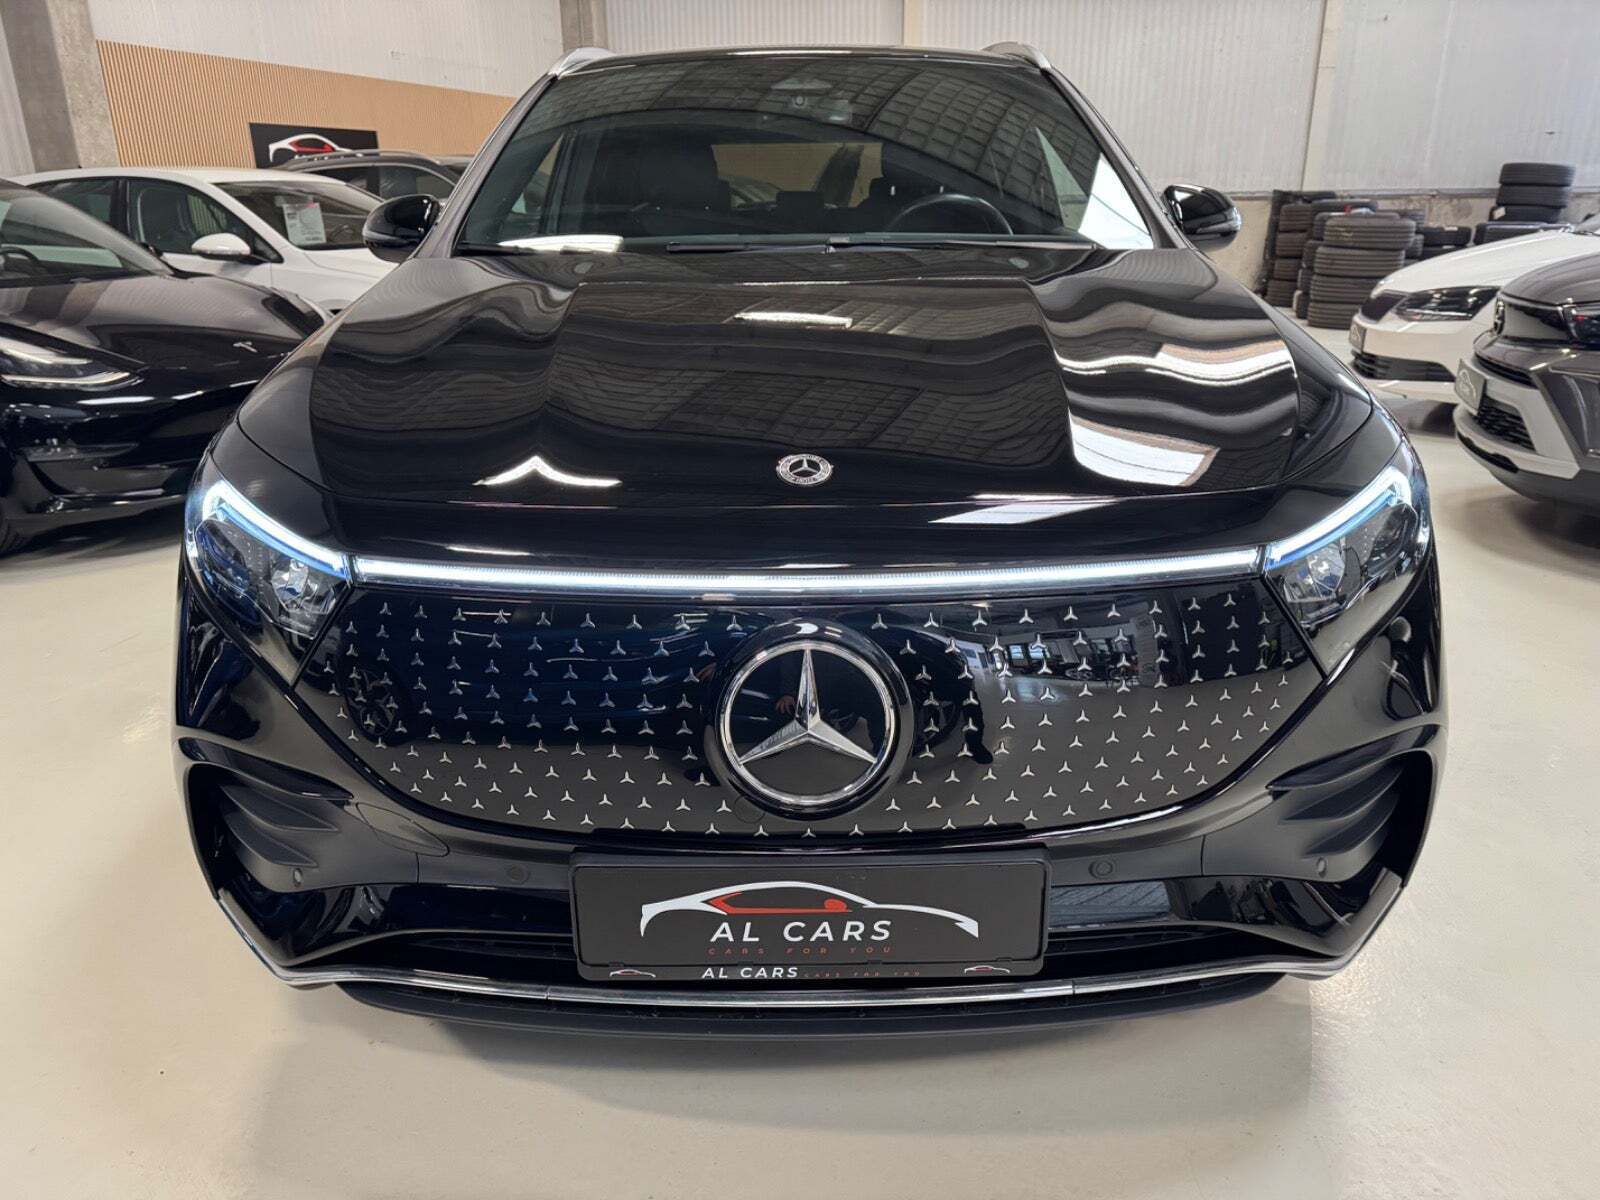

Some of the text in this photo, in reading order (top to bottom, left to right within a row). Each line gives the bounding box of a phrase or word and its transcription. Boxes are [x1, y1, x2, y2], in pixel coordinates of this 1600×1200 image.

[709, 920, 892, 942] AL CARS
[707, 947, 765, 955] CARS
[784, 947, 828, 955] FOR
[702, 967, 729, 979] AL
[740, 966, 799, 978] CARS
